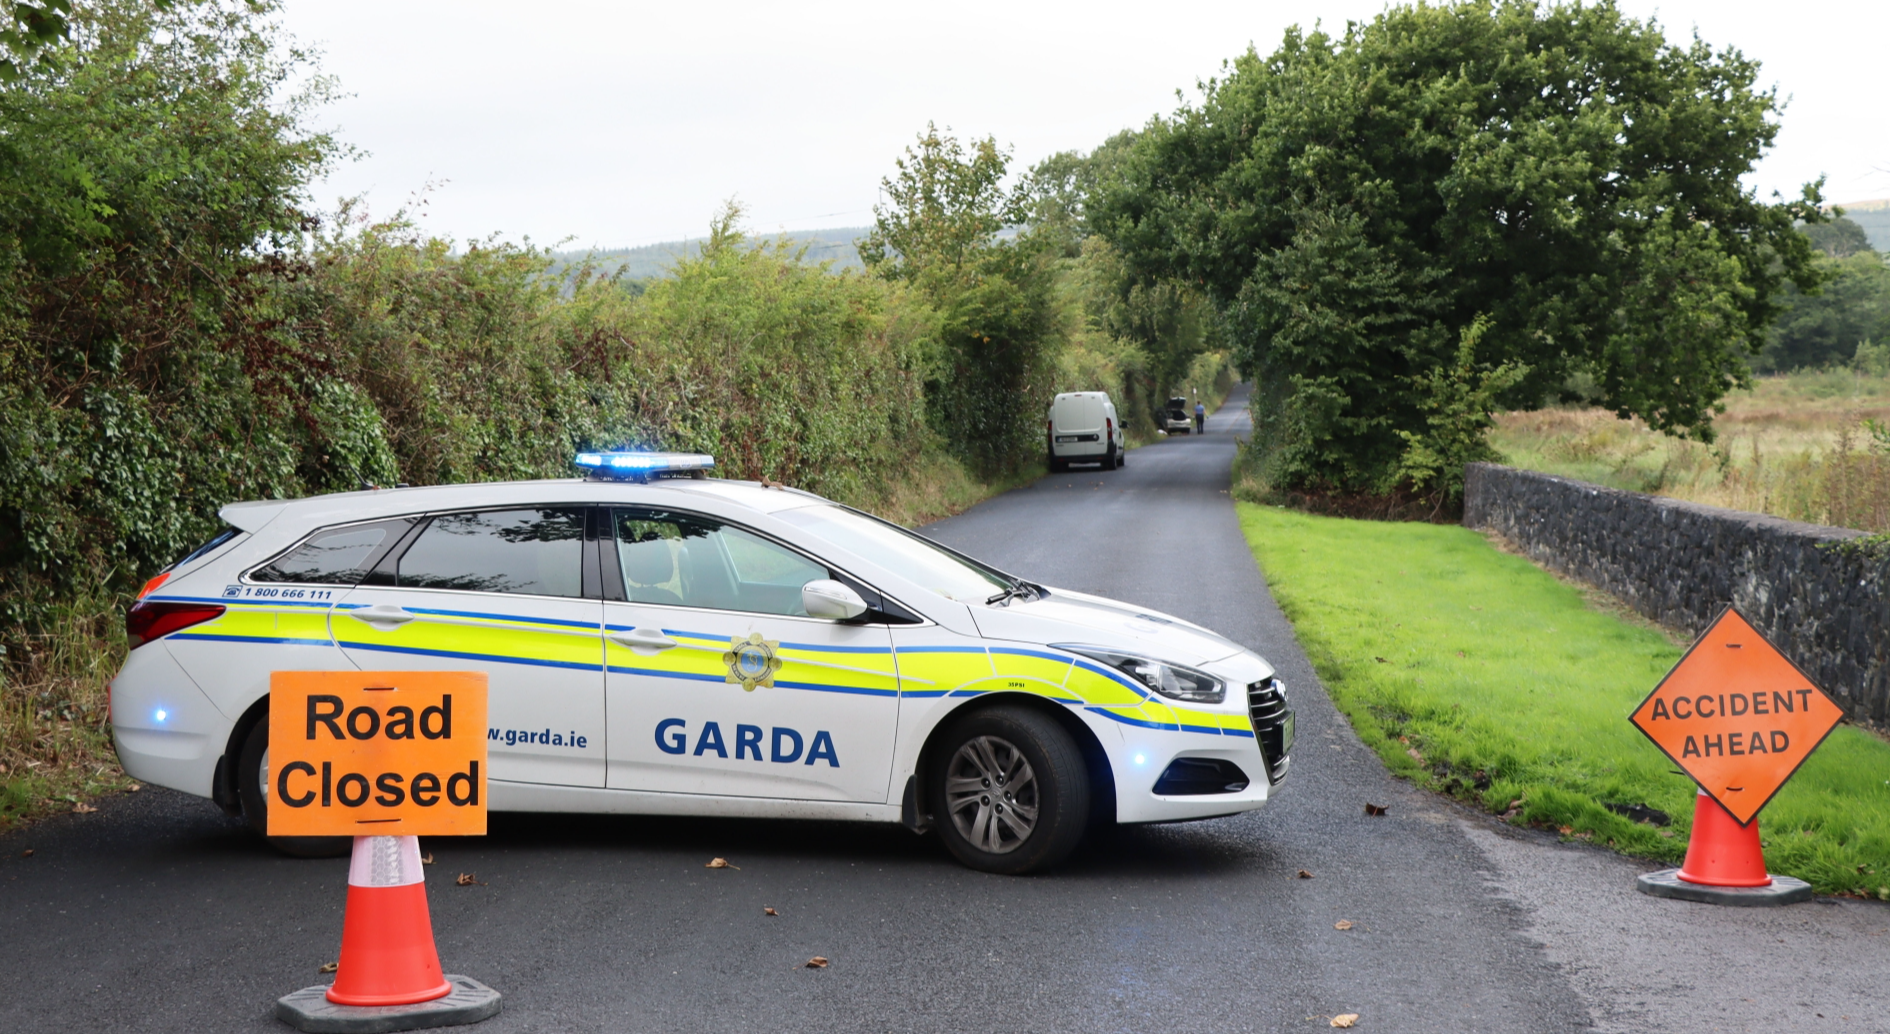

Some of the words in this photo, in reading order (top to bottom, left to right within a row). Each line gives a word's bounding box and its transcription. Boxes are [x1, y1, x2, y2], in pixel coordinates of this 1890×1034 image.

[245, 588, 252, 596] 1
[254, 588, 279, 597] 800
[281, 589, 305, 598] 666
[310, 590, 332, 599] 111
[306, 694, 452, 740] Road
[1651, 688, 1813, 721] ACCIDENT
[654, 717, 841, 768] GARDA
[1682, 730, 1790, 759] AHEAD
[277, 760, 479, 808] Closed
